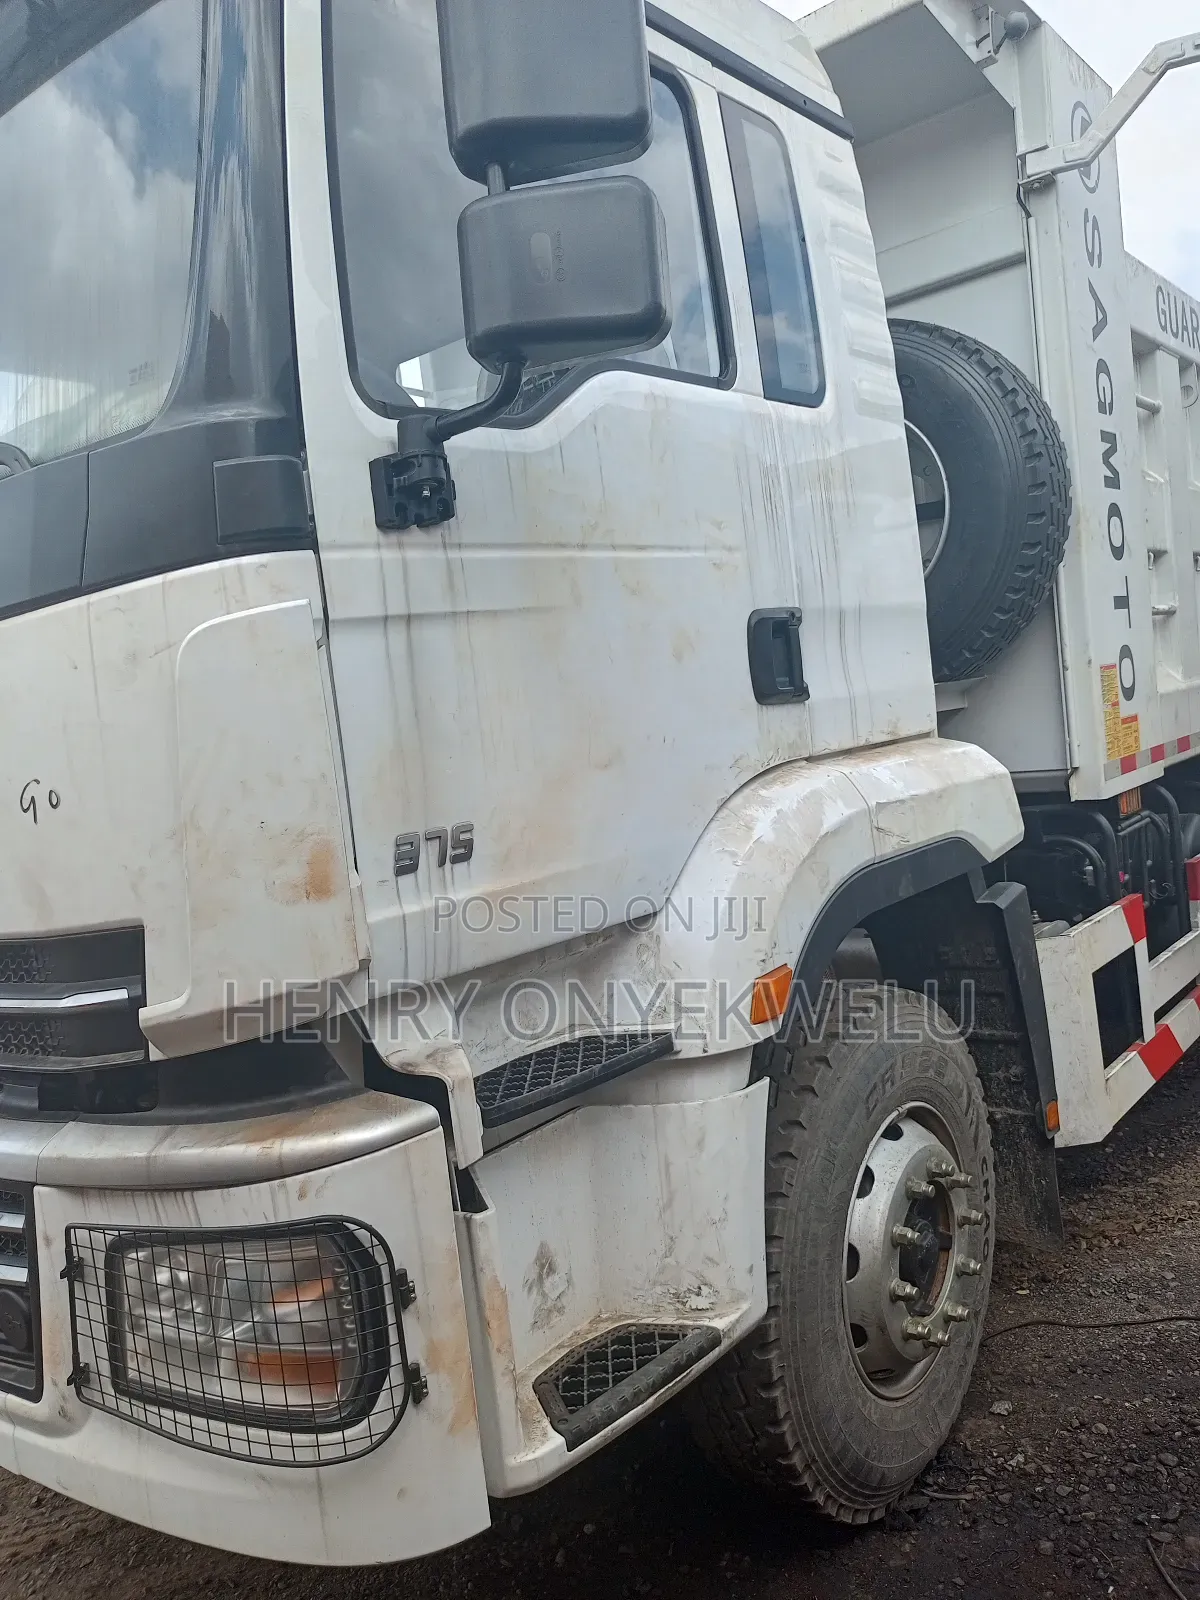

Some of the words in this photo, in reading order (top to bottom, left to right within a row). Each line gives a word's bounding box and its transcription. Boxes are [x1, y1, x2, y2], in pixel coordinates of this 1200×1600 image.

[1156, 284, 1200, 353] GUAR
[1083, 207, 1136, 702] SAGMOTO
[394, 820, 475, 877] 375
